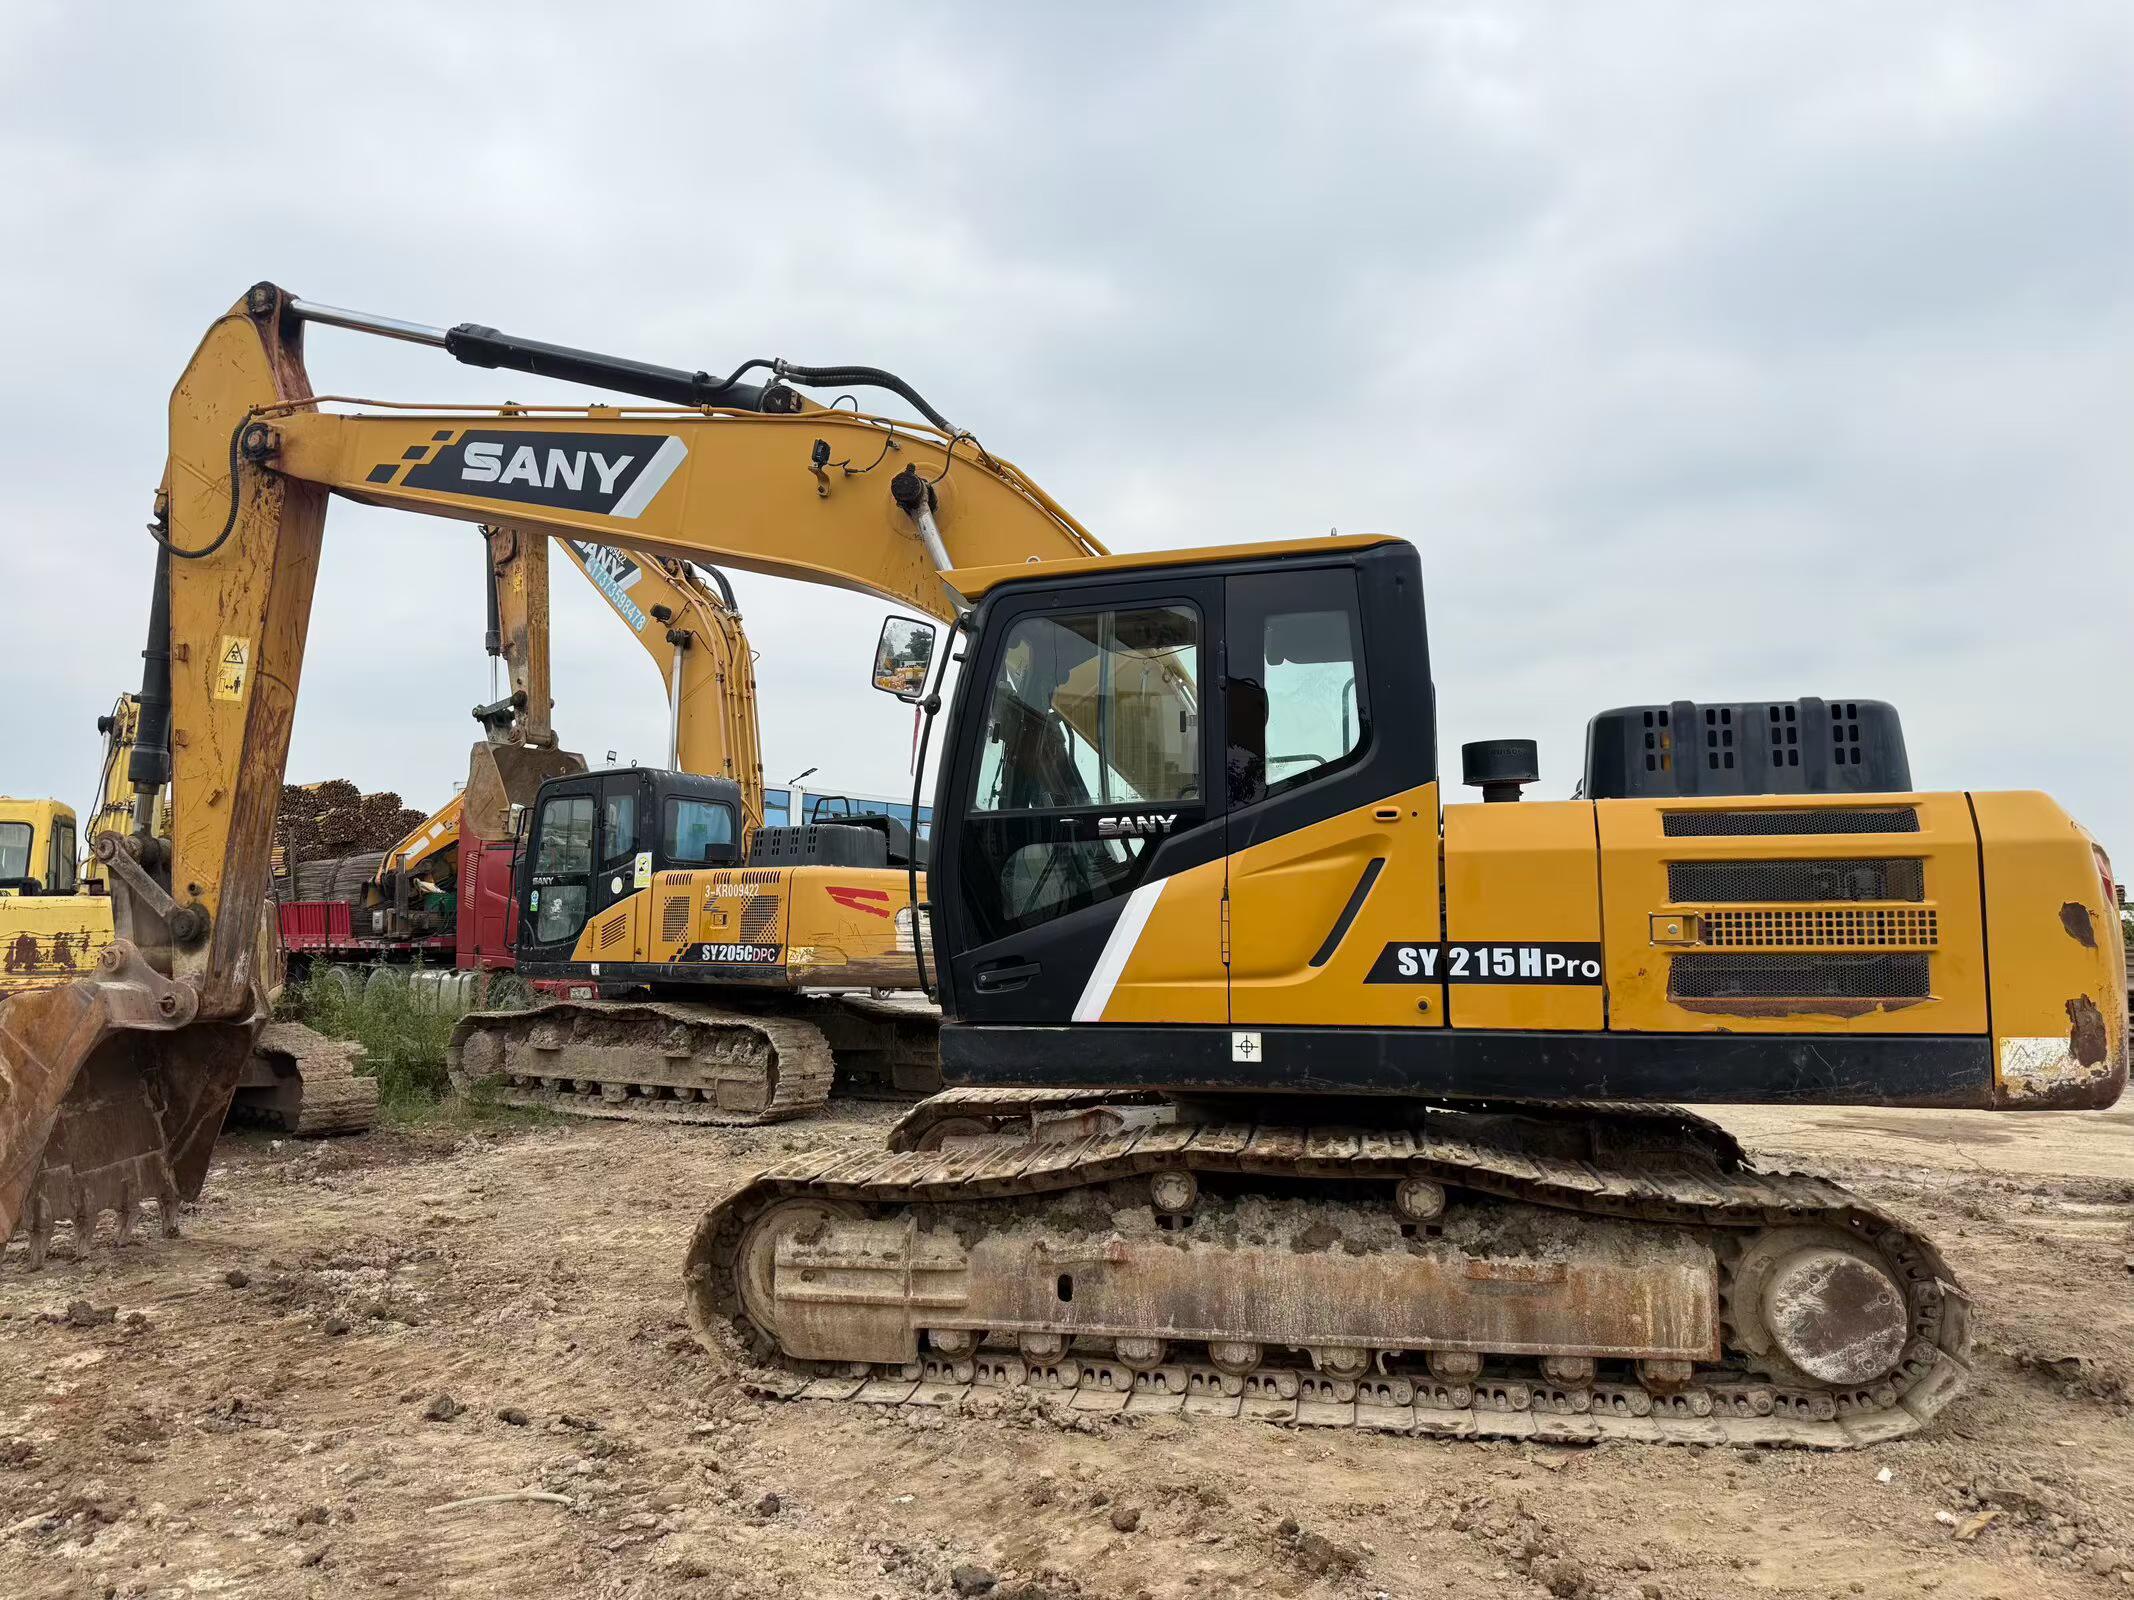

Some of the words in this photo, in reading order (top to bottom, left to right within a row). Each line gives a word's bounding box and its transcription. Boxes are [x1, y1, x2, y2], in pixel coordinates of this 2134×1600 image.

[461, 441, 635, 494] SANY
[1098, 814, 1178, 836] SANY
[705, 884, 760, 898] 3-KR009422
